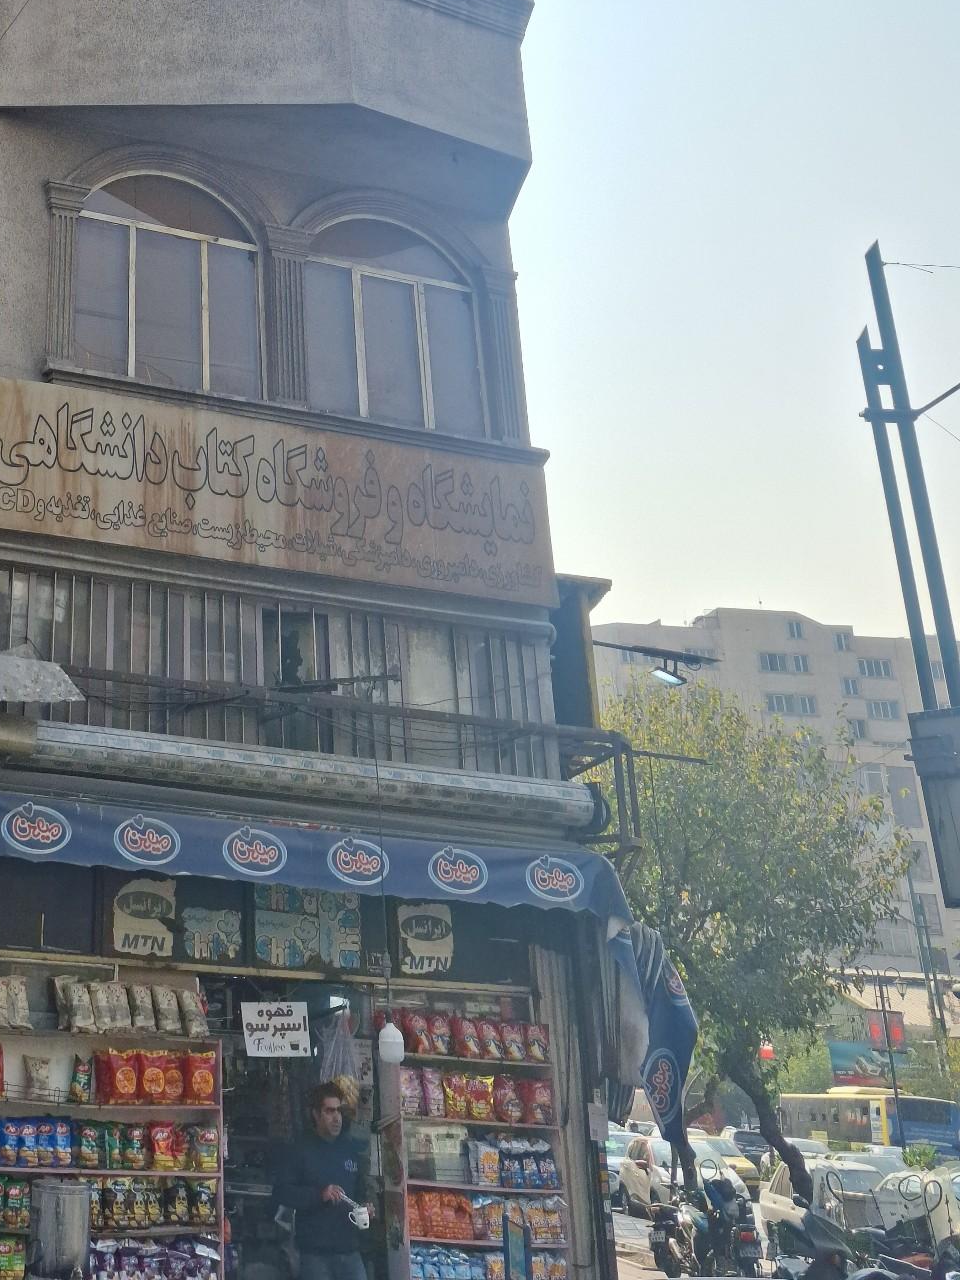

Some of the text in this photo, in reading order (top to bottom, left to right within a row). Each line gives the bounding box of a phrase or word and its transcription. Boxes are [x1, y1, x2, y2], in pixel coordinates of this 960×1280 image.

[172, 427, 254, 511] کتاب
[255, 438, 382, 539] فروشگاه
[46, 491, 90, 522] تغذیه
[384, 484, 404, 545] و
[406, 463, 537, 556] نمایشگاه
[147, 507, 193, 538] صنایع
[12, 814, 62, 843] میهن
[123, 825, 172, 854] میهن
[232, 837, 279, 864] میهن
[335, 845, 381, 875] میهن
[437, 855, 480, 884] میهن
[534, 864, 577, 893] میهن
[122, 933, 165, 952] MTN
[409, 955, 449, 971] MTN
[245, 1015, 308, 1040] اسپرسو
[257, 1005, 293, 1021] قهوه
